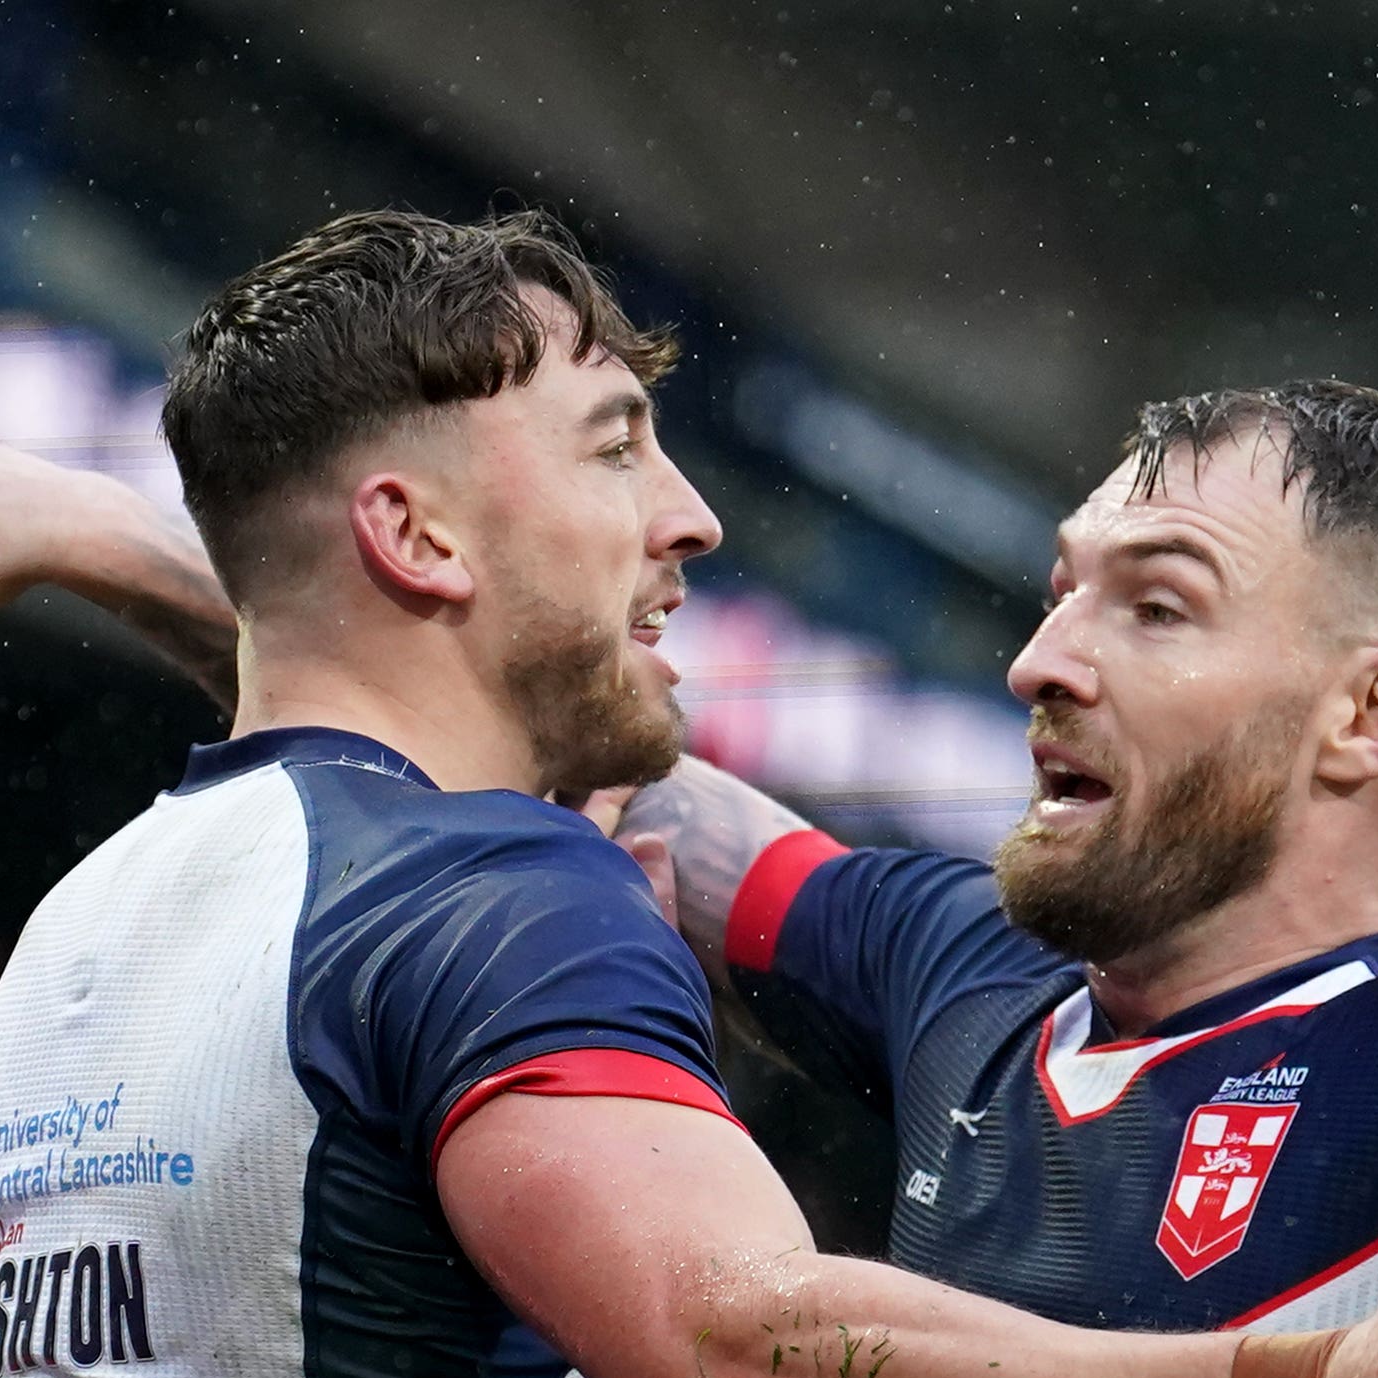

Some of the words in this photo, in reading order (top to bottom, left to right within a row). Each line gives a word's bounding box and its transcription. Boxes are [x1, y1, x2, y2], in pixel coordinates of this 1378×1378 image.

[1218, 1067, 1309, 1093] ENGLAND
[1247, 1087, 1300, 1101] LEAGUE
[95, 1082, 124, 1131] of
[59, 1135, 194, 1191] Lancashire
